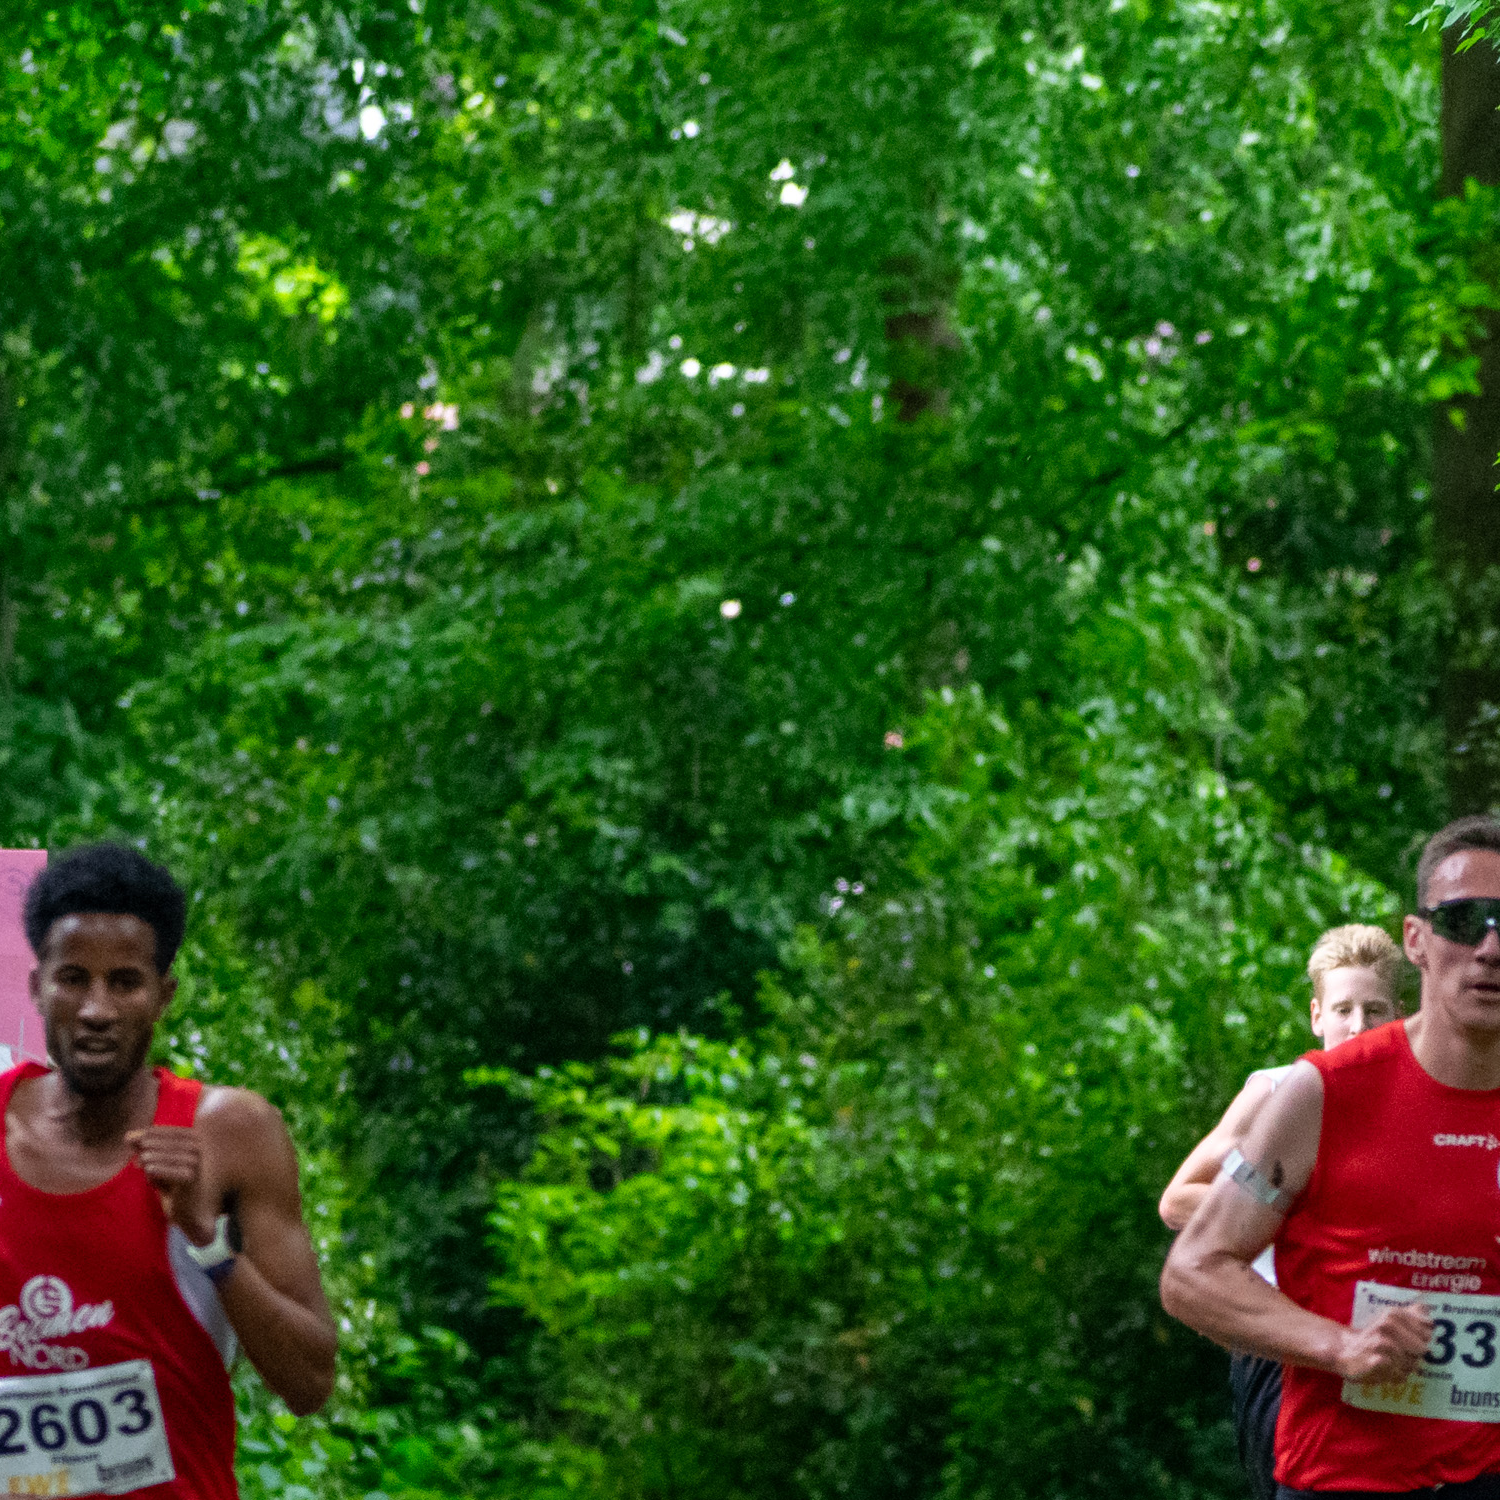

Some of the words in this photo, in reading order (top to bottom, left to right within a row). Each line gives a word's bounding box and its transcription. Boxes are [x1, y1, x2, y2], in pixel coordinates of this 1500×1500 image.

[1433, 1133, 1487, 1149] CRAFT
[1423, 1317, 1498, 1369] 33
[1451, 1385, 1500, 1409] bruns
